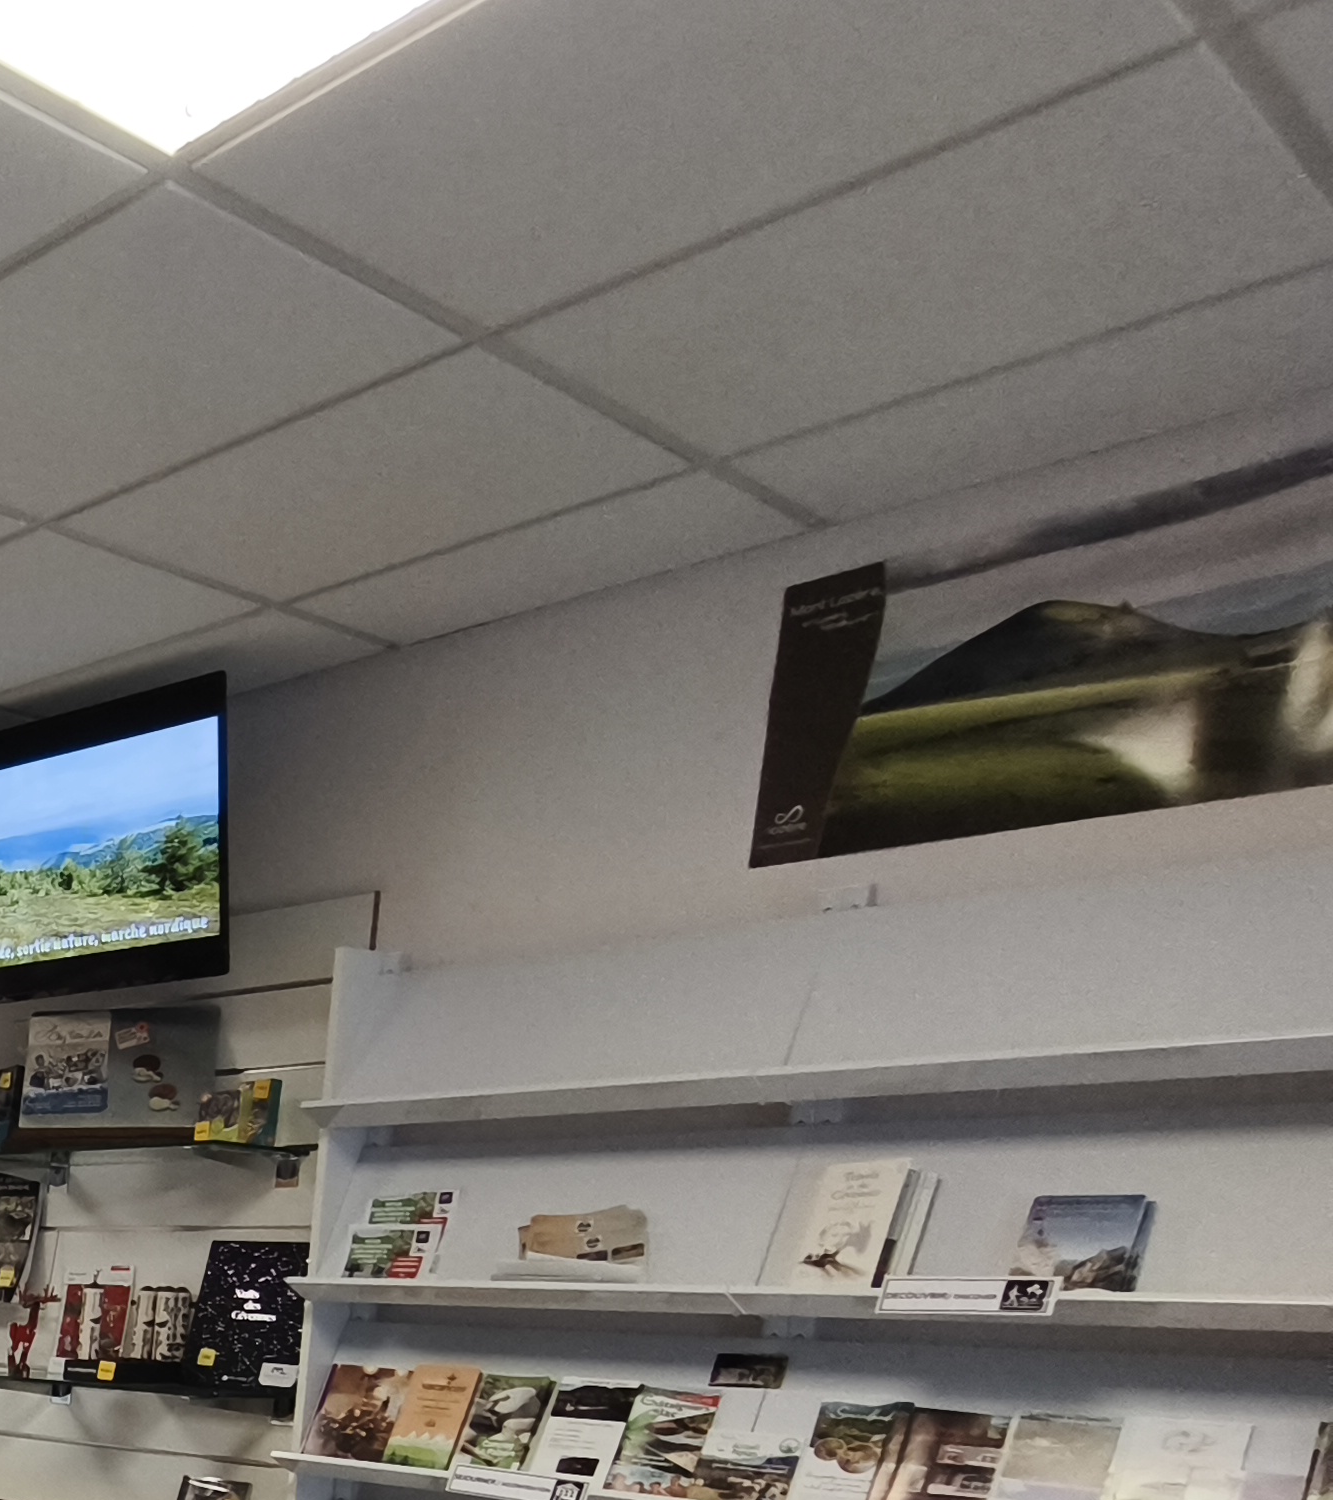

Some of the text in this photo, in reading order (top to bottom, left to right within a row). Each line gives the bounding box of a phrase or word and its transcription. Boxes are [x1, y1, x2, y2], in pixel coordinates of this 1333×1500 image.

[17, 937, 51, 957] sortie
[53, 933, 99, 951] nature,
[101, 923, 147, 944] marche
[149, 915, 209, 936] nordique
